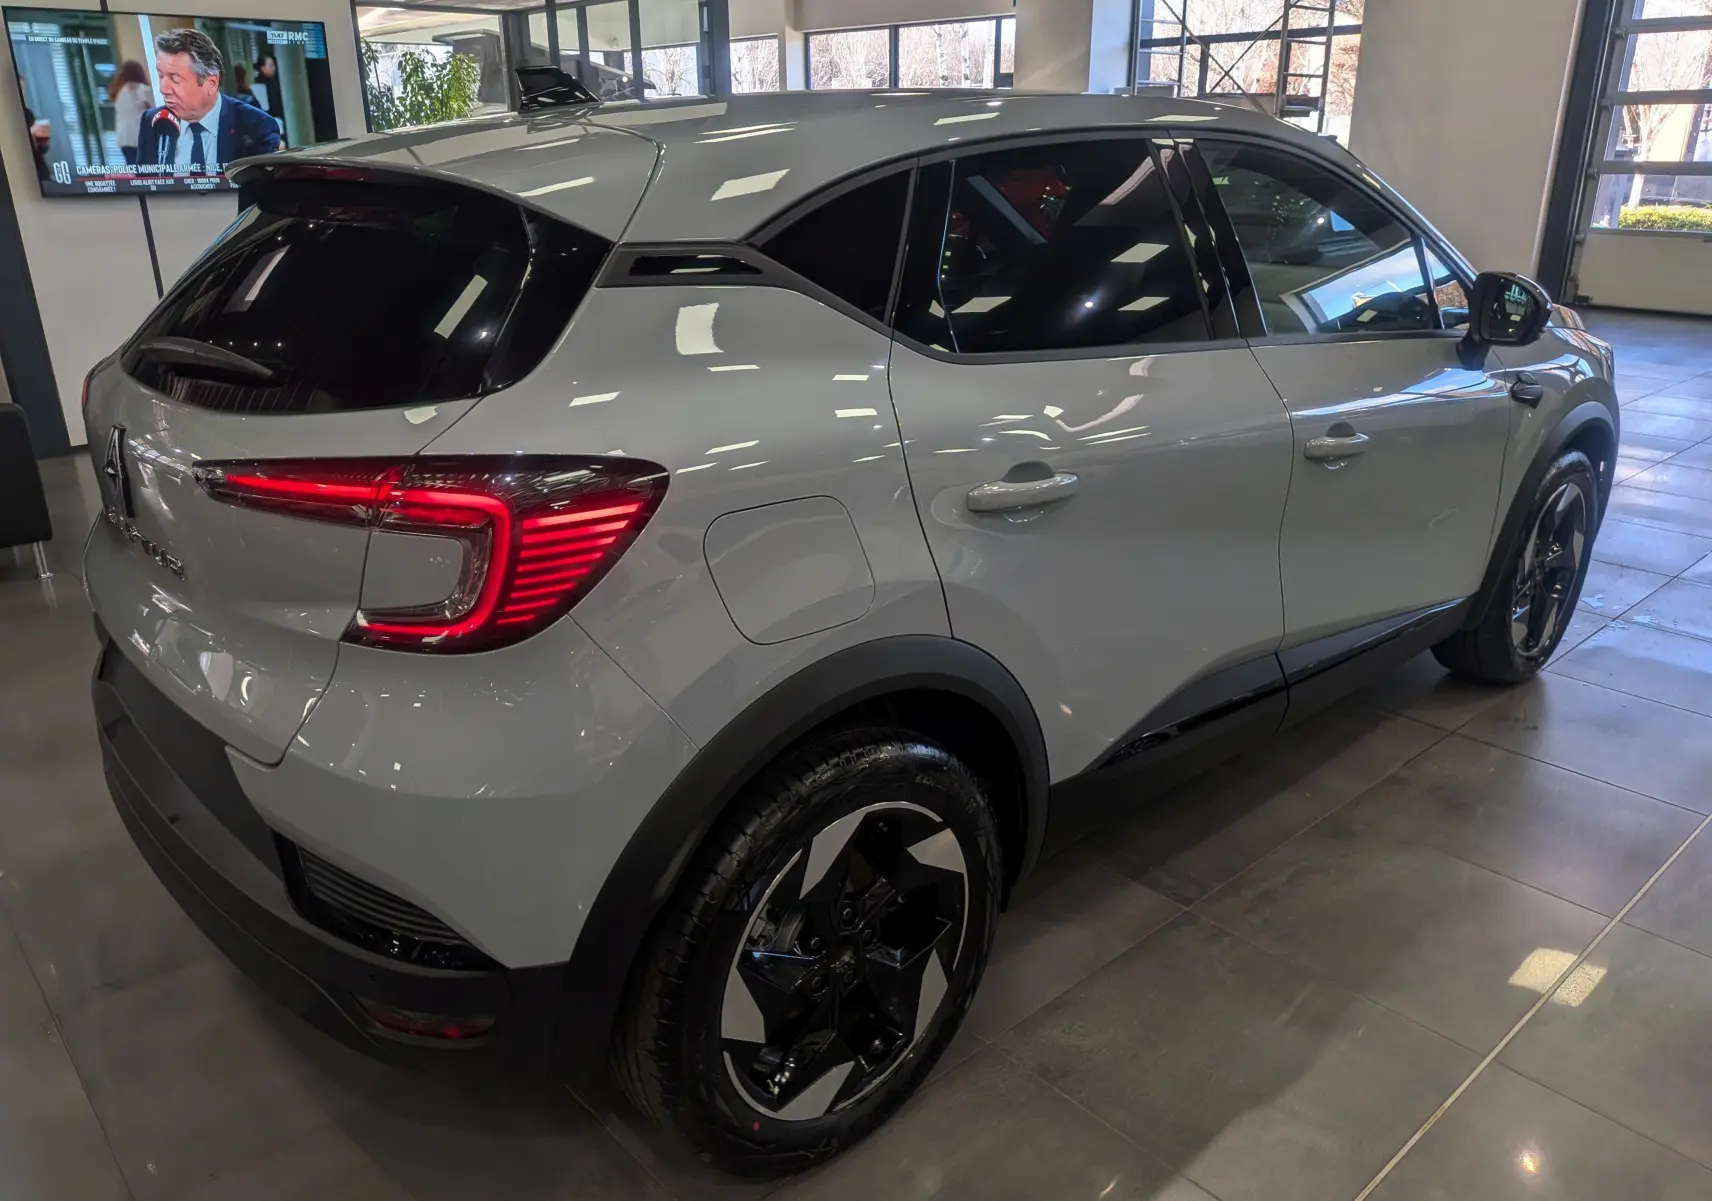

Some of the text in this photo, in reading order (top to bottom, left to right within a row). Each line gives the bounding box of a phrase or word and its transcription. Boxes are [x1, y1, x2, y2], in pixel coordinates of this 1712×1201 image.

[288, 31, 309, 41] RMC
[114, 164, 137, 175] POLICE
[138, 163, 178, 174] MUNICIPALE
[179, 162, 202, 174] ARMÉE
